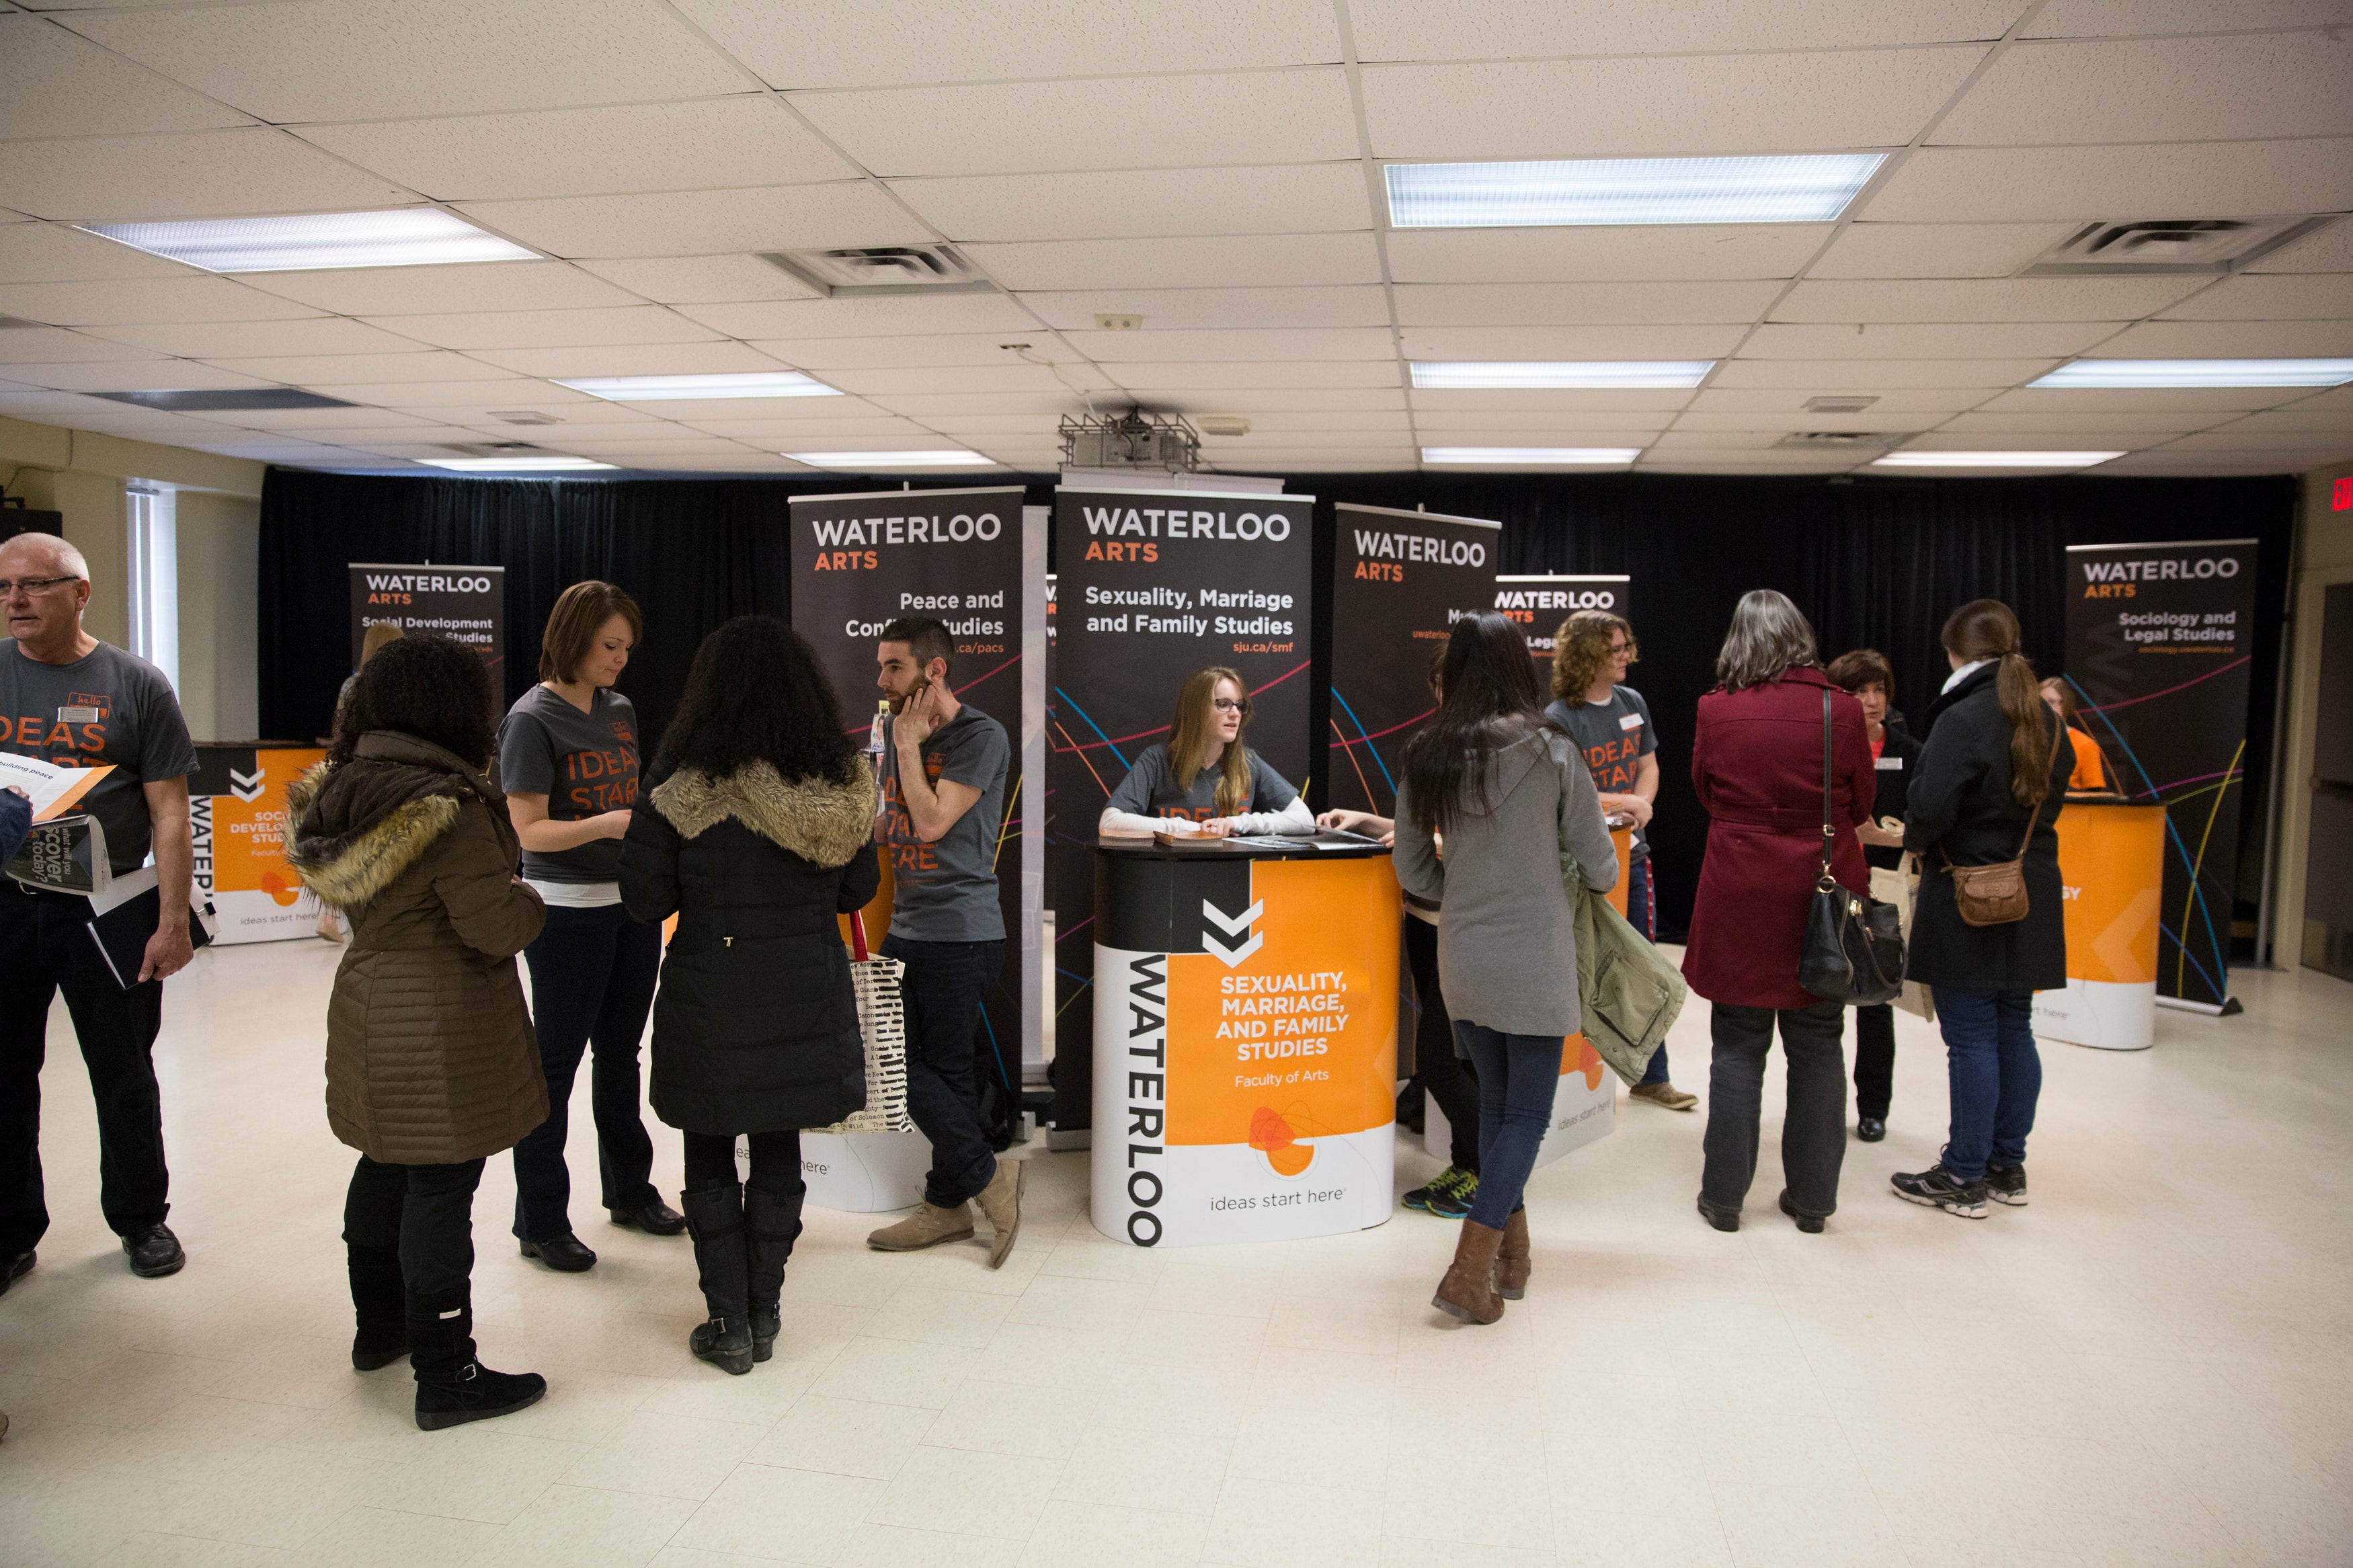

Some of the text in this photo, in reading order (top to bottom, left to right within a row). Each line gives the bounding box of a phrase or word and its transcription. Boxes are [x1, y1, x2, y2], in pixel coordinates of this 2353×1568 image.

[812, 513, 1001, 546] WATERLOO
[1082, 507, 1291, 542] WATERLOO
[1085, 541, 1158, 563] ARTS
[1354, 529, 1486, 567] WATERLOO
[814, 550, 878, 571] ARTS
[2083, 558, 2239, 582] WATERLOO
[1354, 561, 1403, 583] ARTS
[366, 575, 491, 593] WATERLOO
[2084, 583, 2137, 599] ARTS
[368, 593, 412, 605] ARTS
[900, 590, 1004, 610] Peace and
[1086, 586, 1293, 612] Sexuality, Marriage
[406, 616, 493, 630] Development
[1087, 614, 1293, 636] and Family Studies
[1503, 610, 1534, 623] RTS
[2119, 610, 2237, 627] Sociology and
[445, 632, 493, 643] Studies
[1527, 635, 1558, 649] Lega
[2124, 627, 2235, 644] Legal Studies
[1233, 642, 1293, 654] sju.ca/smf
[77, 695, 102, 706] hello
[0, 715, 106, 752] DEAS
[568, 745, 638, 780] IDEA
[29, 769, 54, 780] peace
[570, 777, 638, 811] STAR
[62, 828, 72, 875] what will you
[191, 796, 212, 898] WATER
[890, 842, 939, 870] ERE
[32, 841, 48, 882] today?
[241, 912, 318, 925] ideas start here
[1220, 972, 1347, 994] SEXUALITY,
[1222, 993, 1345, 1017] MARRIAGE,
[1215, 1015, 1349, 1039] AND FAMILY
[1237, 1037, 1328, 1061] STUDIES
[1234, 1069, 1329, 1088] Faculty of Arts
[1127, 954, 1166, 1247] WATERLOO
[1210, 1187, 1344, 1212] ideas start here
